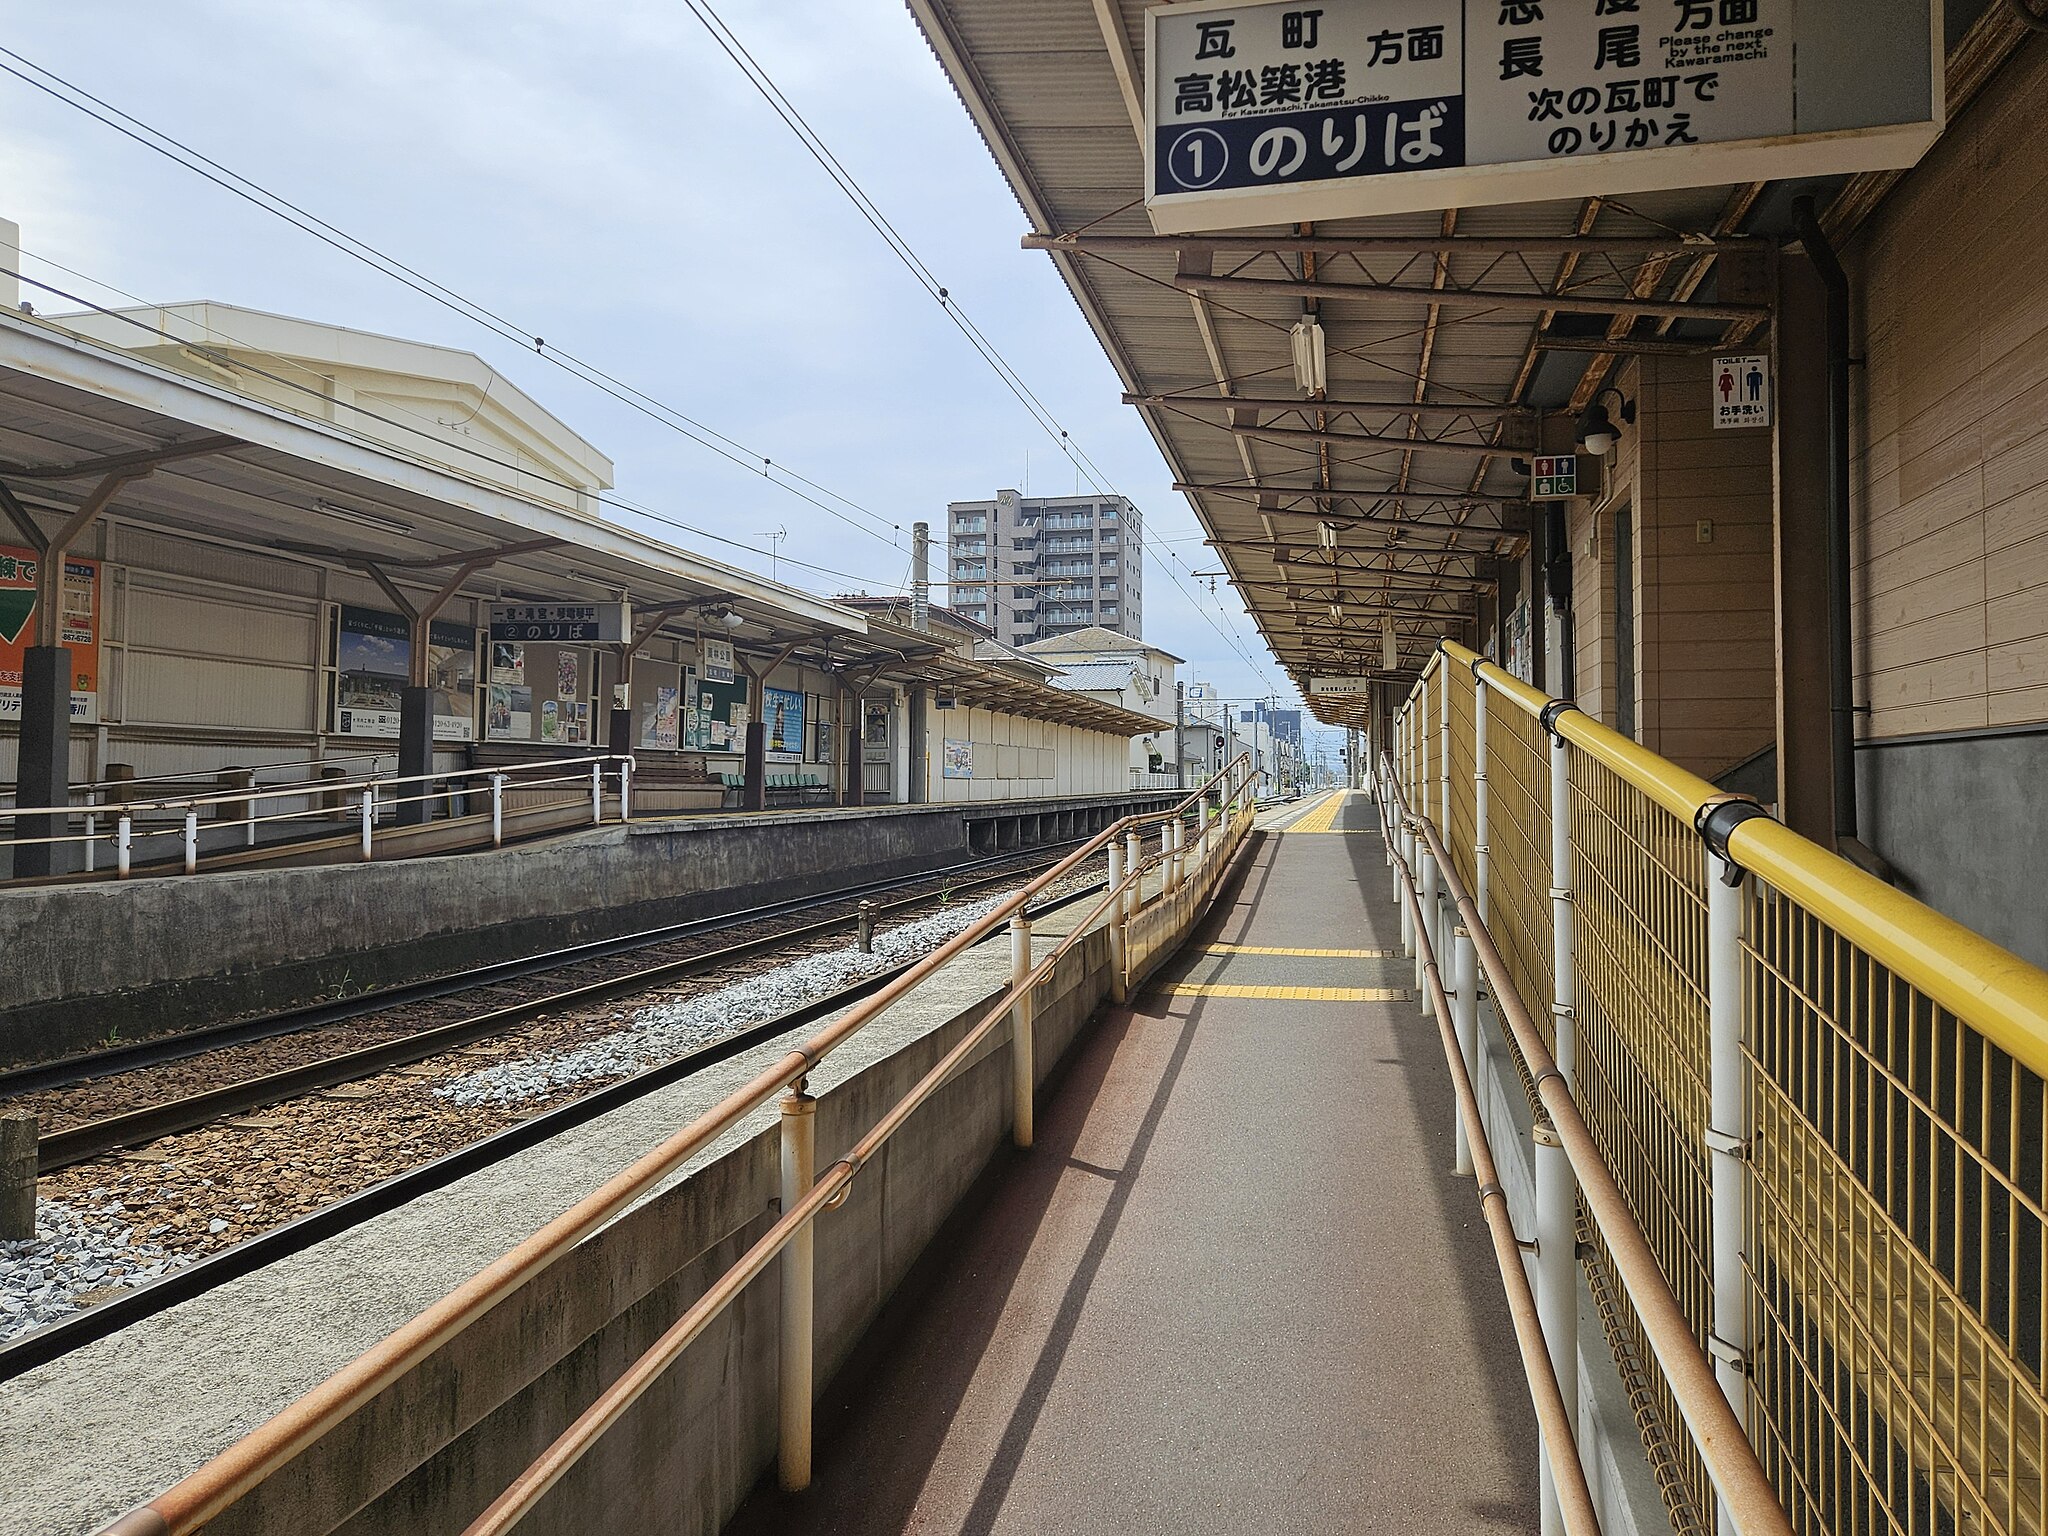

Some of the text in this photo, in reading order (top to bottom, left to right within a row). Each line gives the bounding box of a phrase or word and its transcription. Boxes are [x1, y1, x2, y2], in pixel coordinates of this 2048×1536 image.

[1366, 25, 1444, 67] 方面
[1659, 28, 1774, 48] Please change
[1670, 39, 1762, 58] by the next
[1665, 47, 1768, 69] Kawaramachi
[1174, 58, 1346, 115] 高松築港
[1527, 72, 1719, 123] 次の瓦町で
[1221, 110, 1238, 119] For
[1547, 112, 1699, 154] のりかえ
[1717, 357, 1747, 365] TOILET
[1719, 404, 1764, 416] お手洗い
